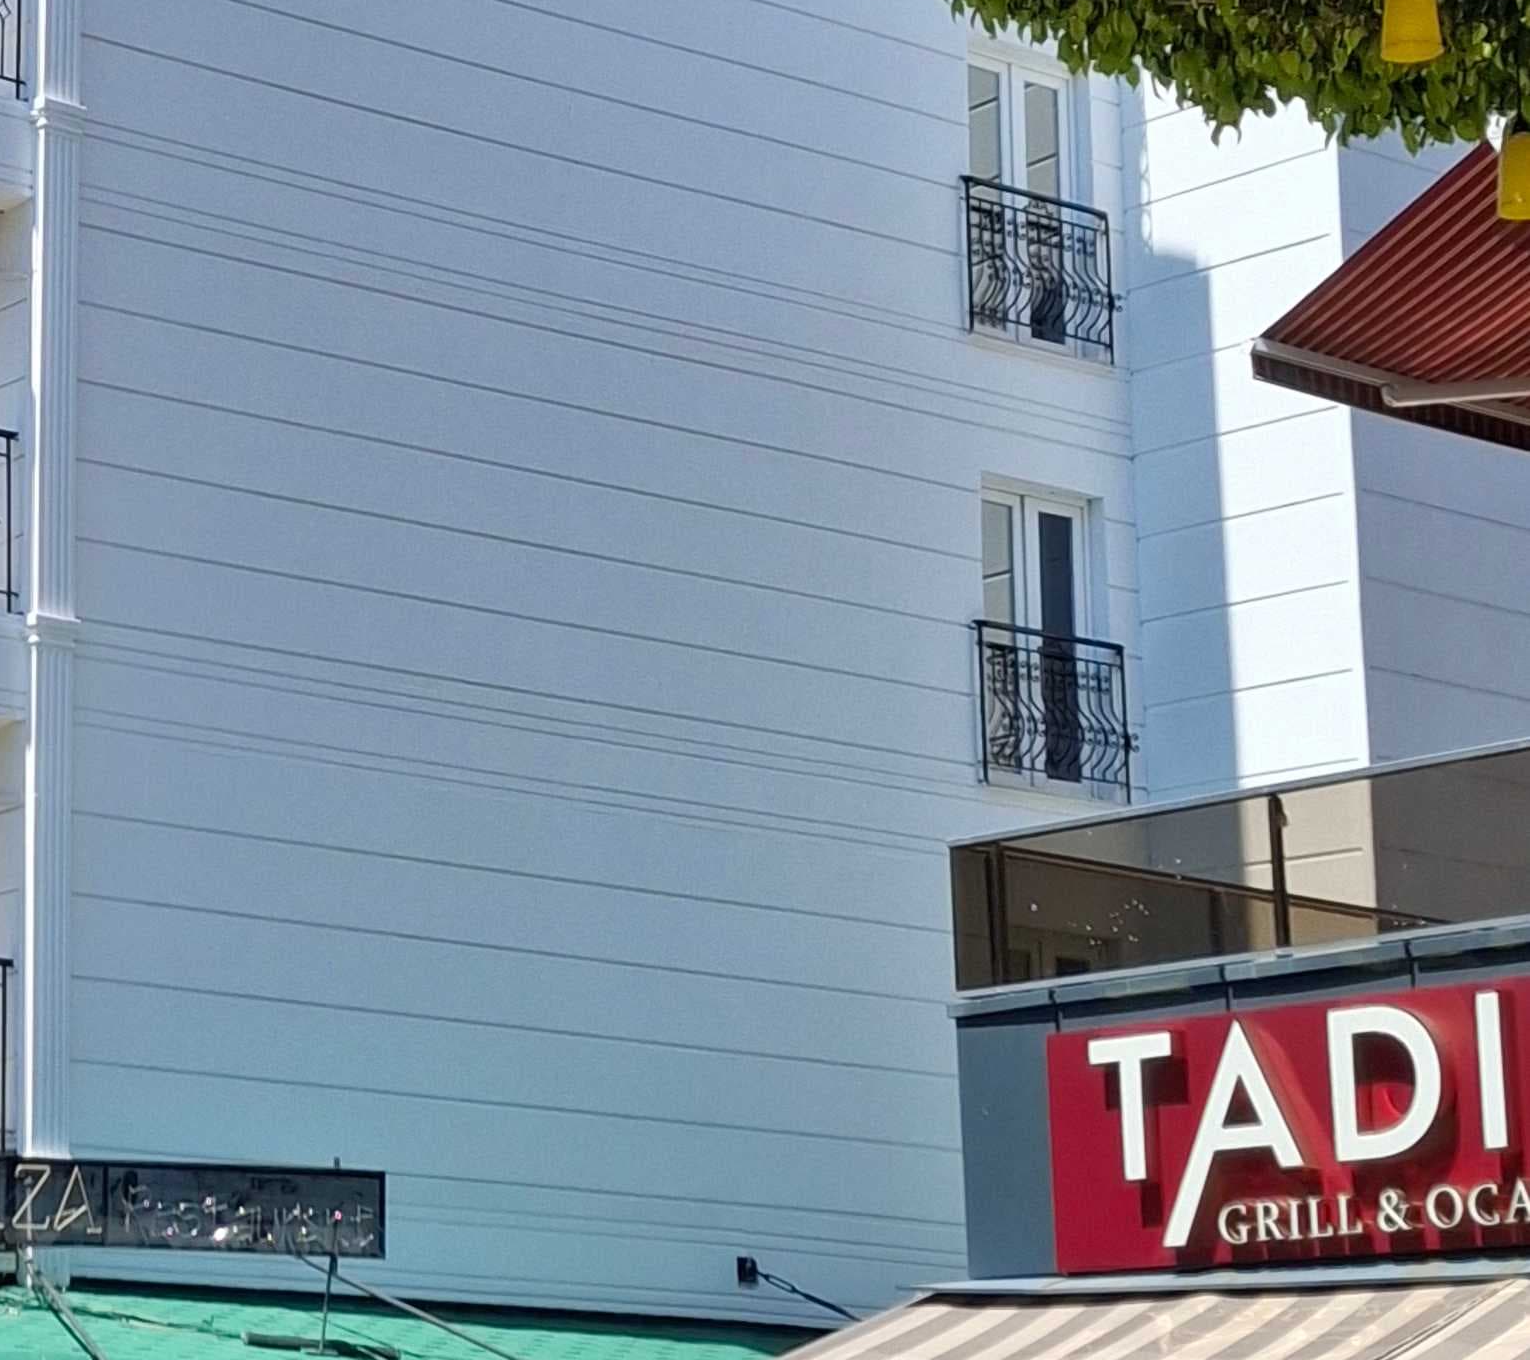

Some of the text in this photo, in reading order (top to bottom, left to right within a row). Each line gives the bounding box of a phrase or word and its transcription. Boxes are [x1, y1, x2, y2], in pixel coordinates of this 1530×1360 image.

[1087, 990, 1509, 1248] TADI
[1217, 1176, 1530, 1246] GRILL & OCA
